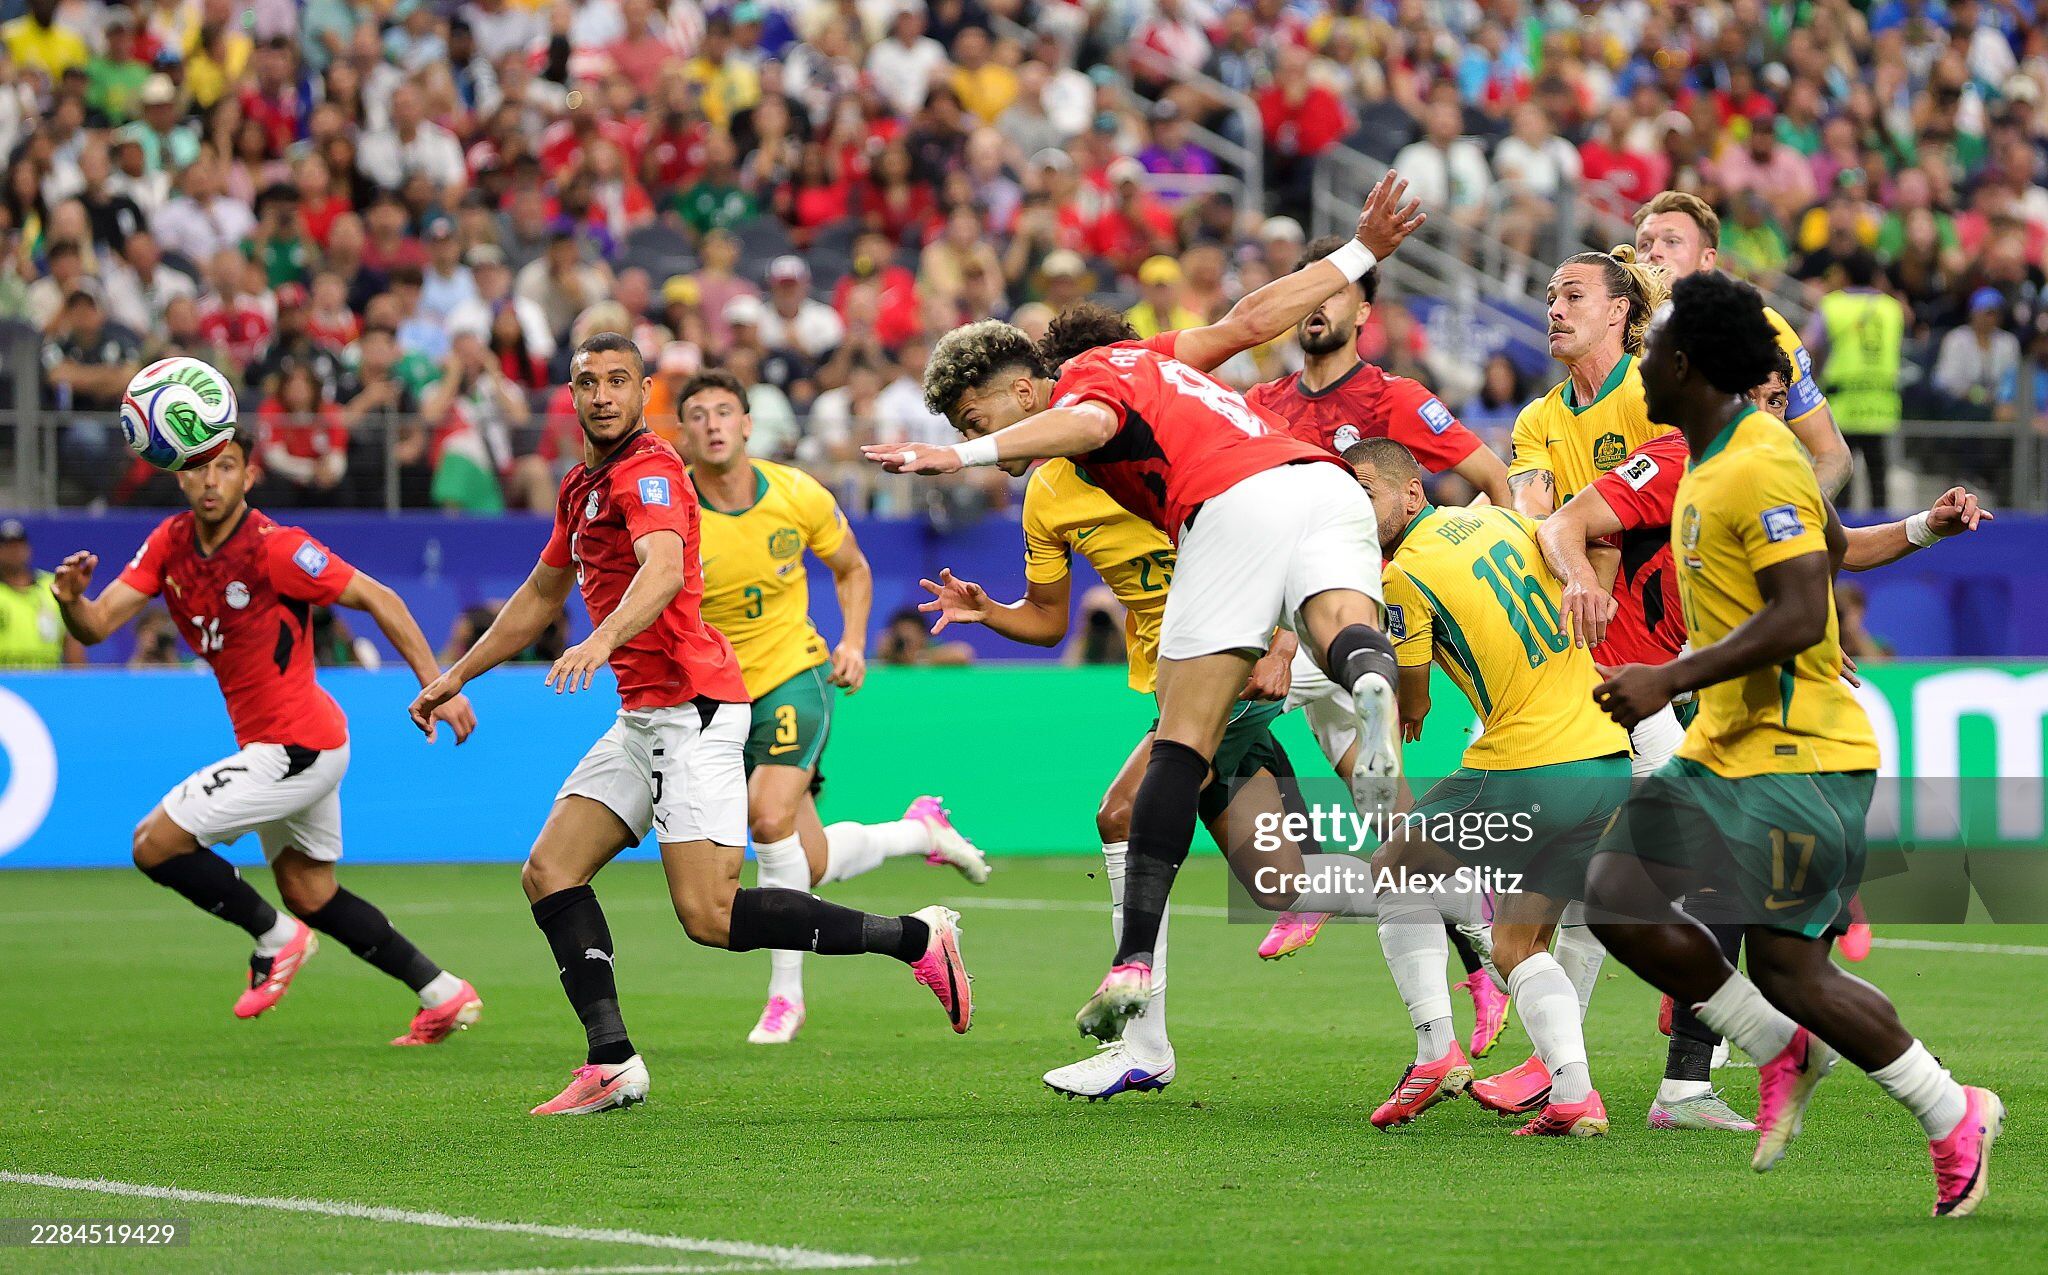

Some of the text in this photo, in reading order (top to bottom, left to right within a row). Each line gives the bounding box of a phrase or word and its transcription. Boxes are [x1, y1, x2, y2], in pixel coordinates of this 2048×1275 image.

[1128, 551, 1176, 593] 25
[744, 585, 763, 620] 3
[1471, 539, 1571, 670] 16
[191, 615, 225, 653] 14
[774, 704, 798, 745] 3
[1768, 827, 1816, 892] 17
